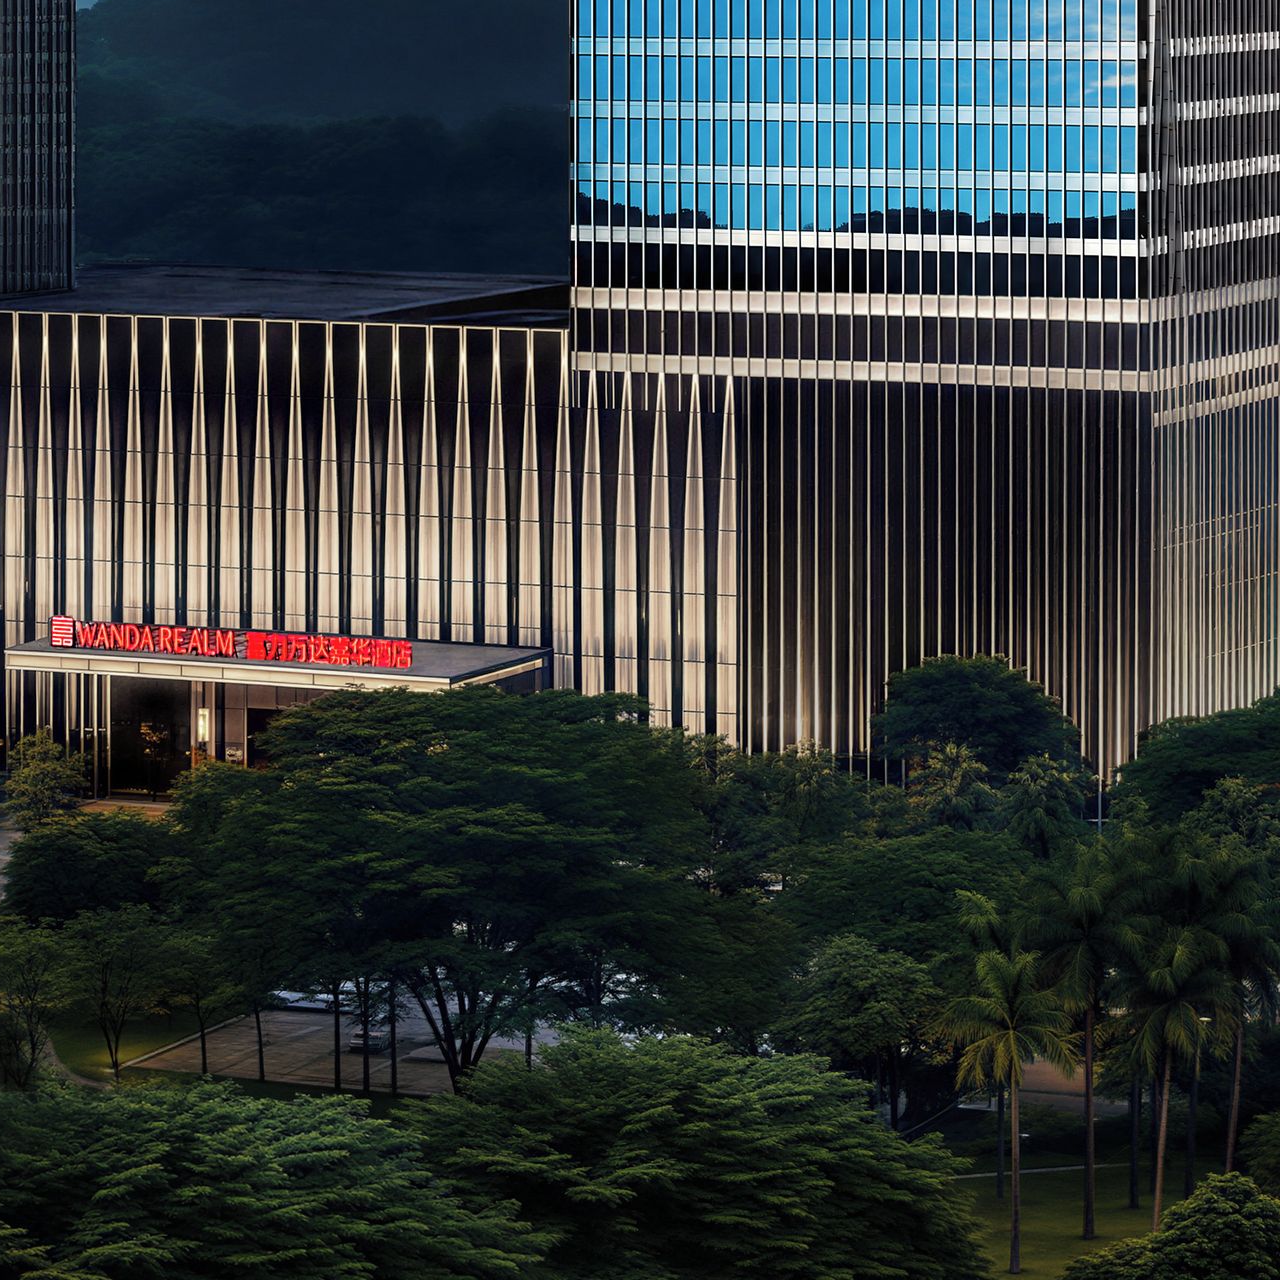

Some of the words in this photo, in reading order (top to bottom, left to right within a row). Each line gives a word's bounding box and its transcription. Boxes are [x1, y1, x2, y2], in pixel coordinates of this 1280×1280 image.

[75, 620, 155, 652] WANDA
[158, 625, 235, 657] REALM
[246, 630, 413, 669] 力万达嘉华酒店
